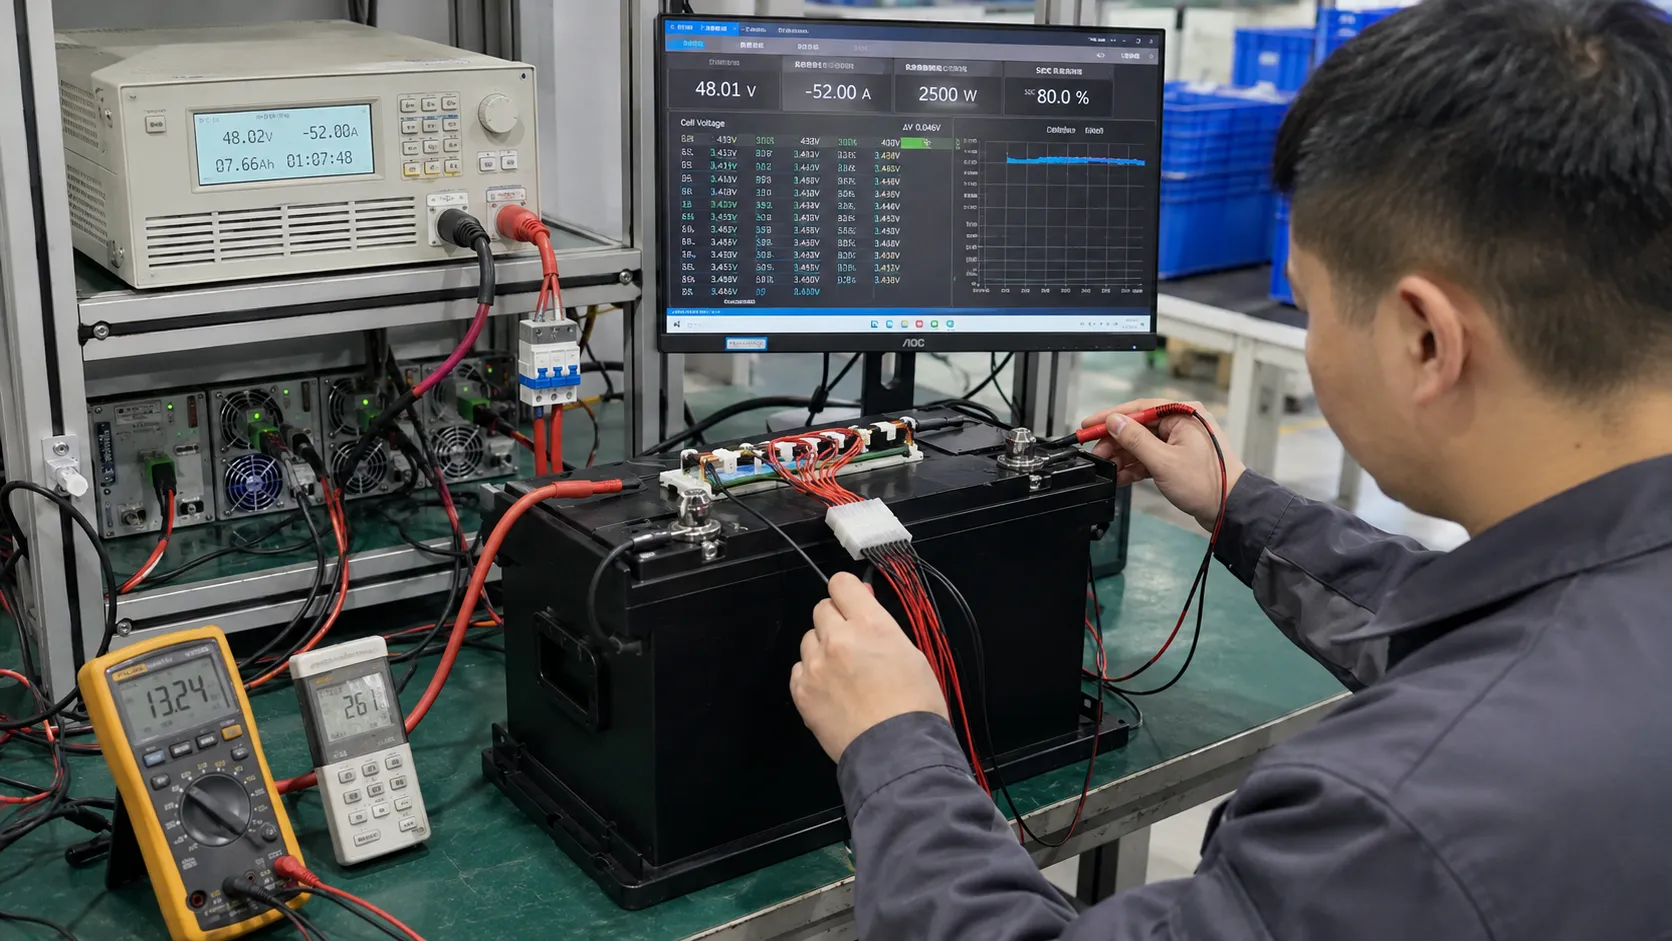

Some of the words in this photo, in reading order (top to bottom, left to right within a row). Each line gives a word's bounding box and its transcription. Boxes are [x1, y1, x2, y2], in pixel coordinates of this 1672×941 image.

[695, 81, 741, 97] 48.01
[747, 85, 757, 97] V
[805, 83, 857, 100] -52.00
[862, 88, 872, 100] A
[919, 86, 958, 102] 2500
[963, 90, 978, 102] W
[1037, 88, 1071, 104] 80.0
[1075, 90, 1090, 105] %
[680, 118, 695, 127] Cell
[697, 119, 725, 129] Voltage
[222, 129, 273, 145] 48.02V
[303, 123, 359, 140] -52.00A
[215, 156, 275, 173] 07.66Ah
[286, 150, 353, 168] 01:07:48
[902, 338, 925, 348] AOC
[147, 675, 208, 718] 13.24
[343, 689, 378, 720] 261
